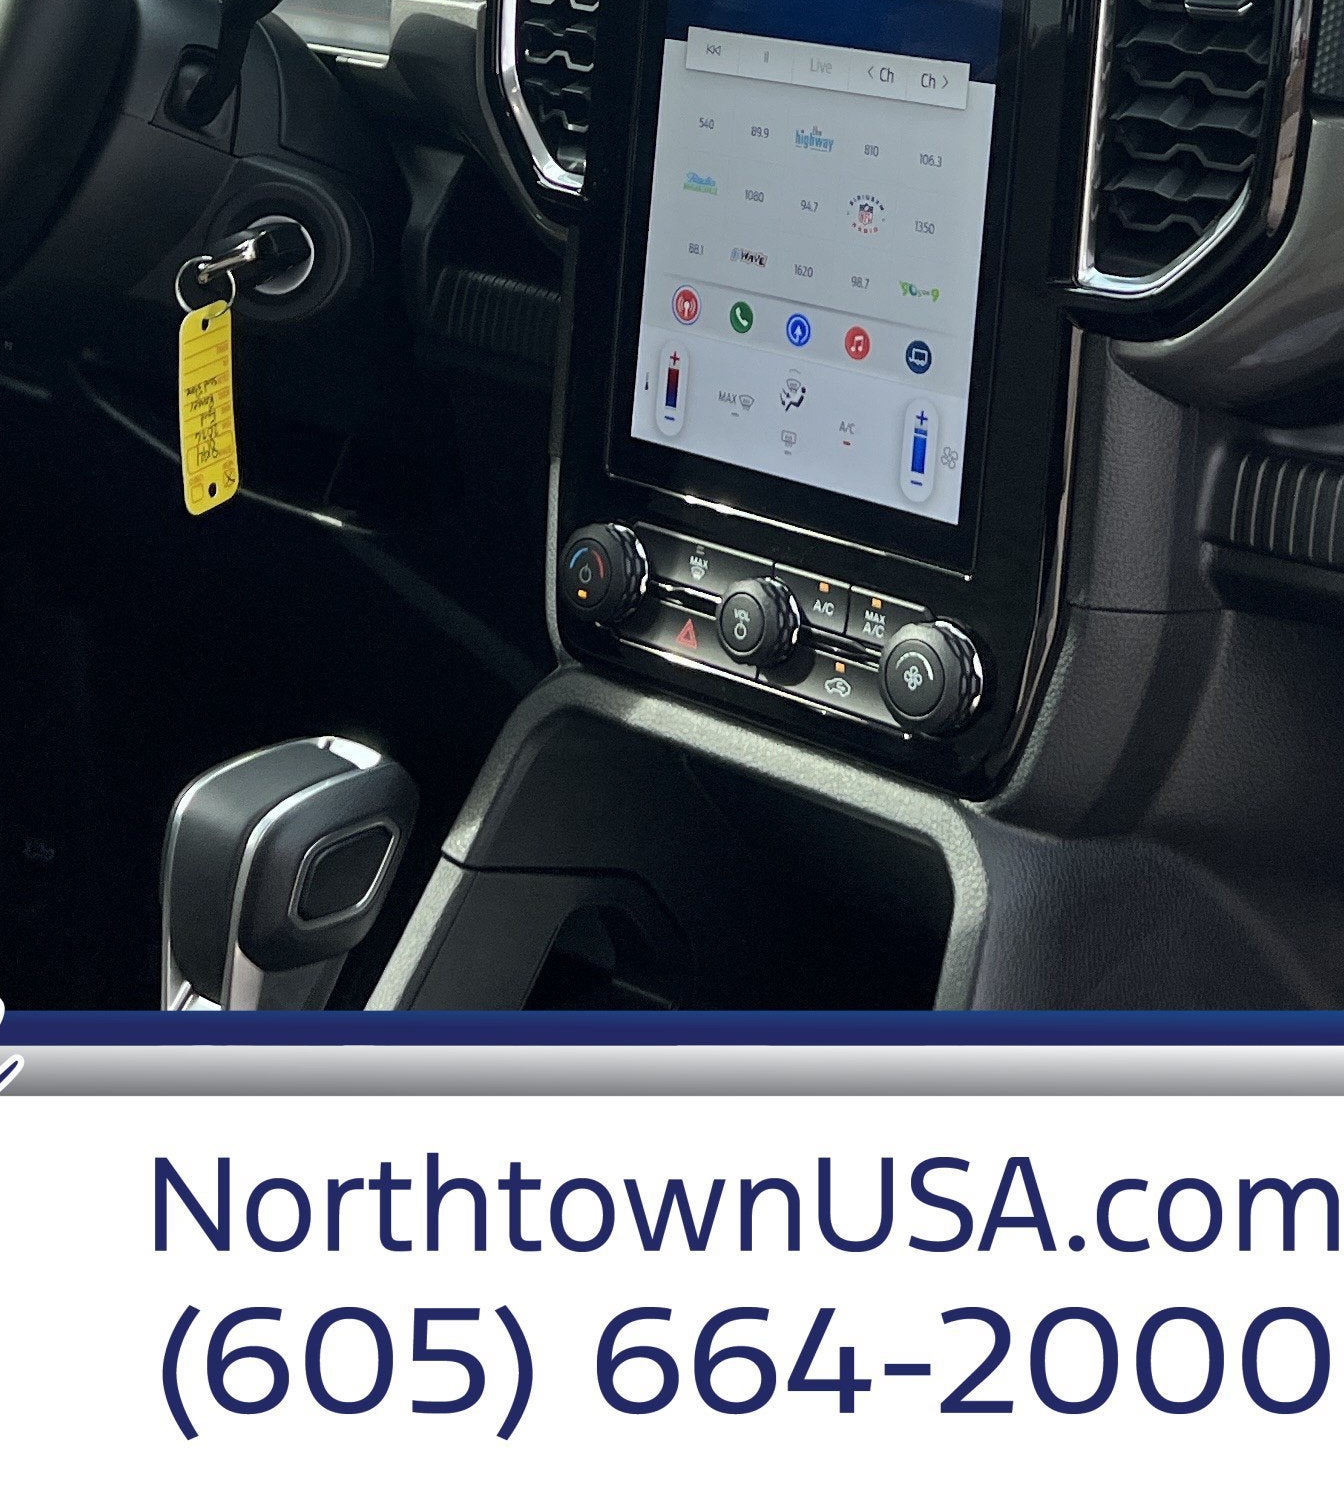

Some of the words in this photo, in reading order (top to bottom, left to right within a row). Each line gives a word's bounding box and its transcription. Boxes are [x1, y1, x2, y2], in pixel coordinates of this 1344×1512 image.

[810, 57, 833, 75] Live
[879, 67, 895, 84] Ch
[920, 73, 936, 90] Ch
[795, 129, 835, 153] highway
[919, 153, 943, 168] 106.3
[800, 199, 819, 213] 94.7
[915, 220, 936, 235] 1350
[794, 264, 815, 278] 1620
[718, 390, 737, 405] MAX
[839, 421, 856, 435] A/C
[689, 555, 708, 570] MAX
[734, 608, 751, 623] VOL
[813, 599, 835, 617] A/C
[864, 610, 886, 625] MAX
[862, 622, 885, 638] A/C
